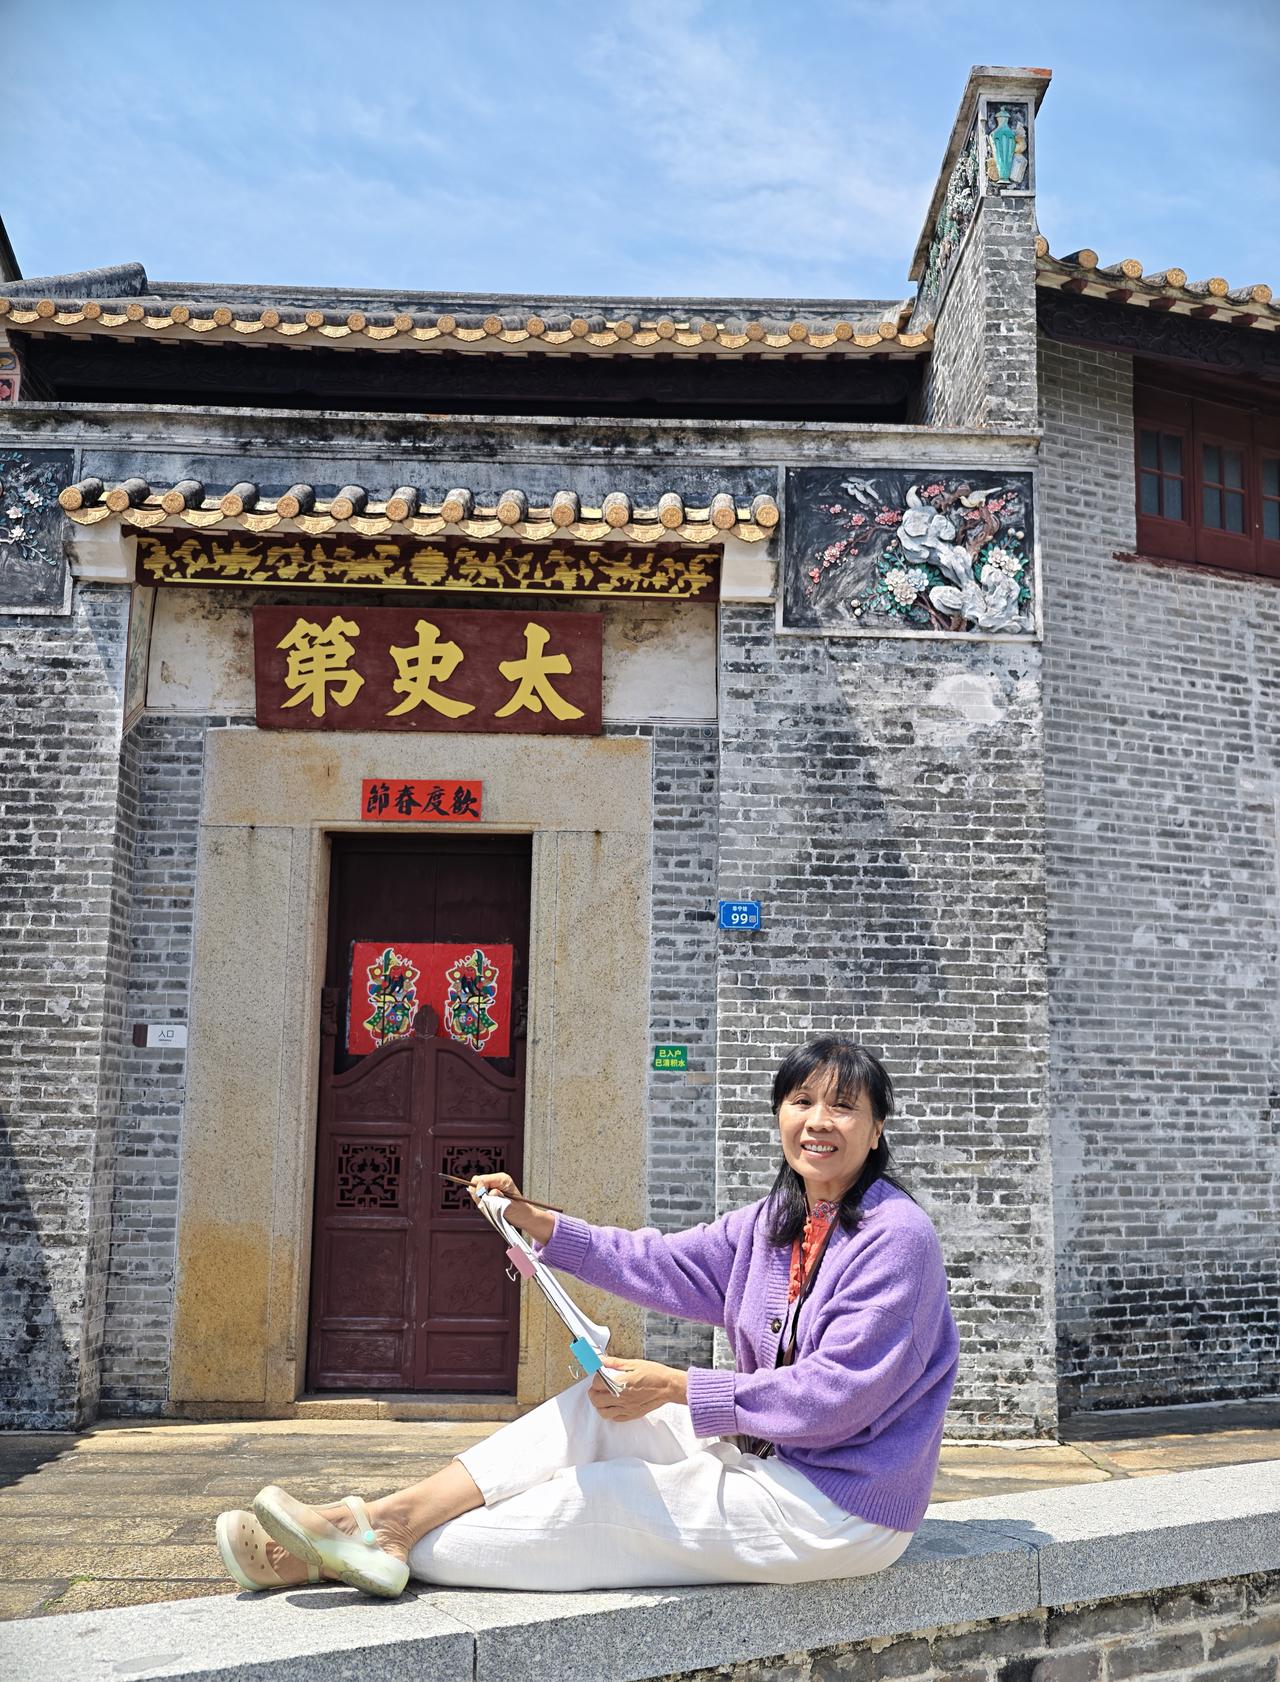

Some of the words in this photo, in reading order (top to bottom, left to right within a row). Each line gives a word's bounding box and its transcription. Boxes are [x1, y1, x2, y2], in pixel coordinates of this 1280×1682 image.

[276, 615, 585, 721] 太史第
[731, 913, 748, 925] 99
[158, 1029, 175, 1038] 入口
[659, 1049, 682, 1058] 已入户
